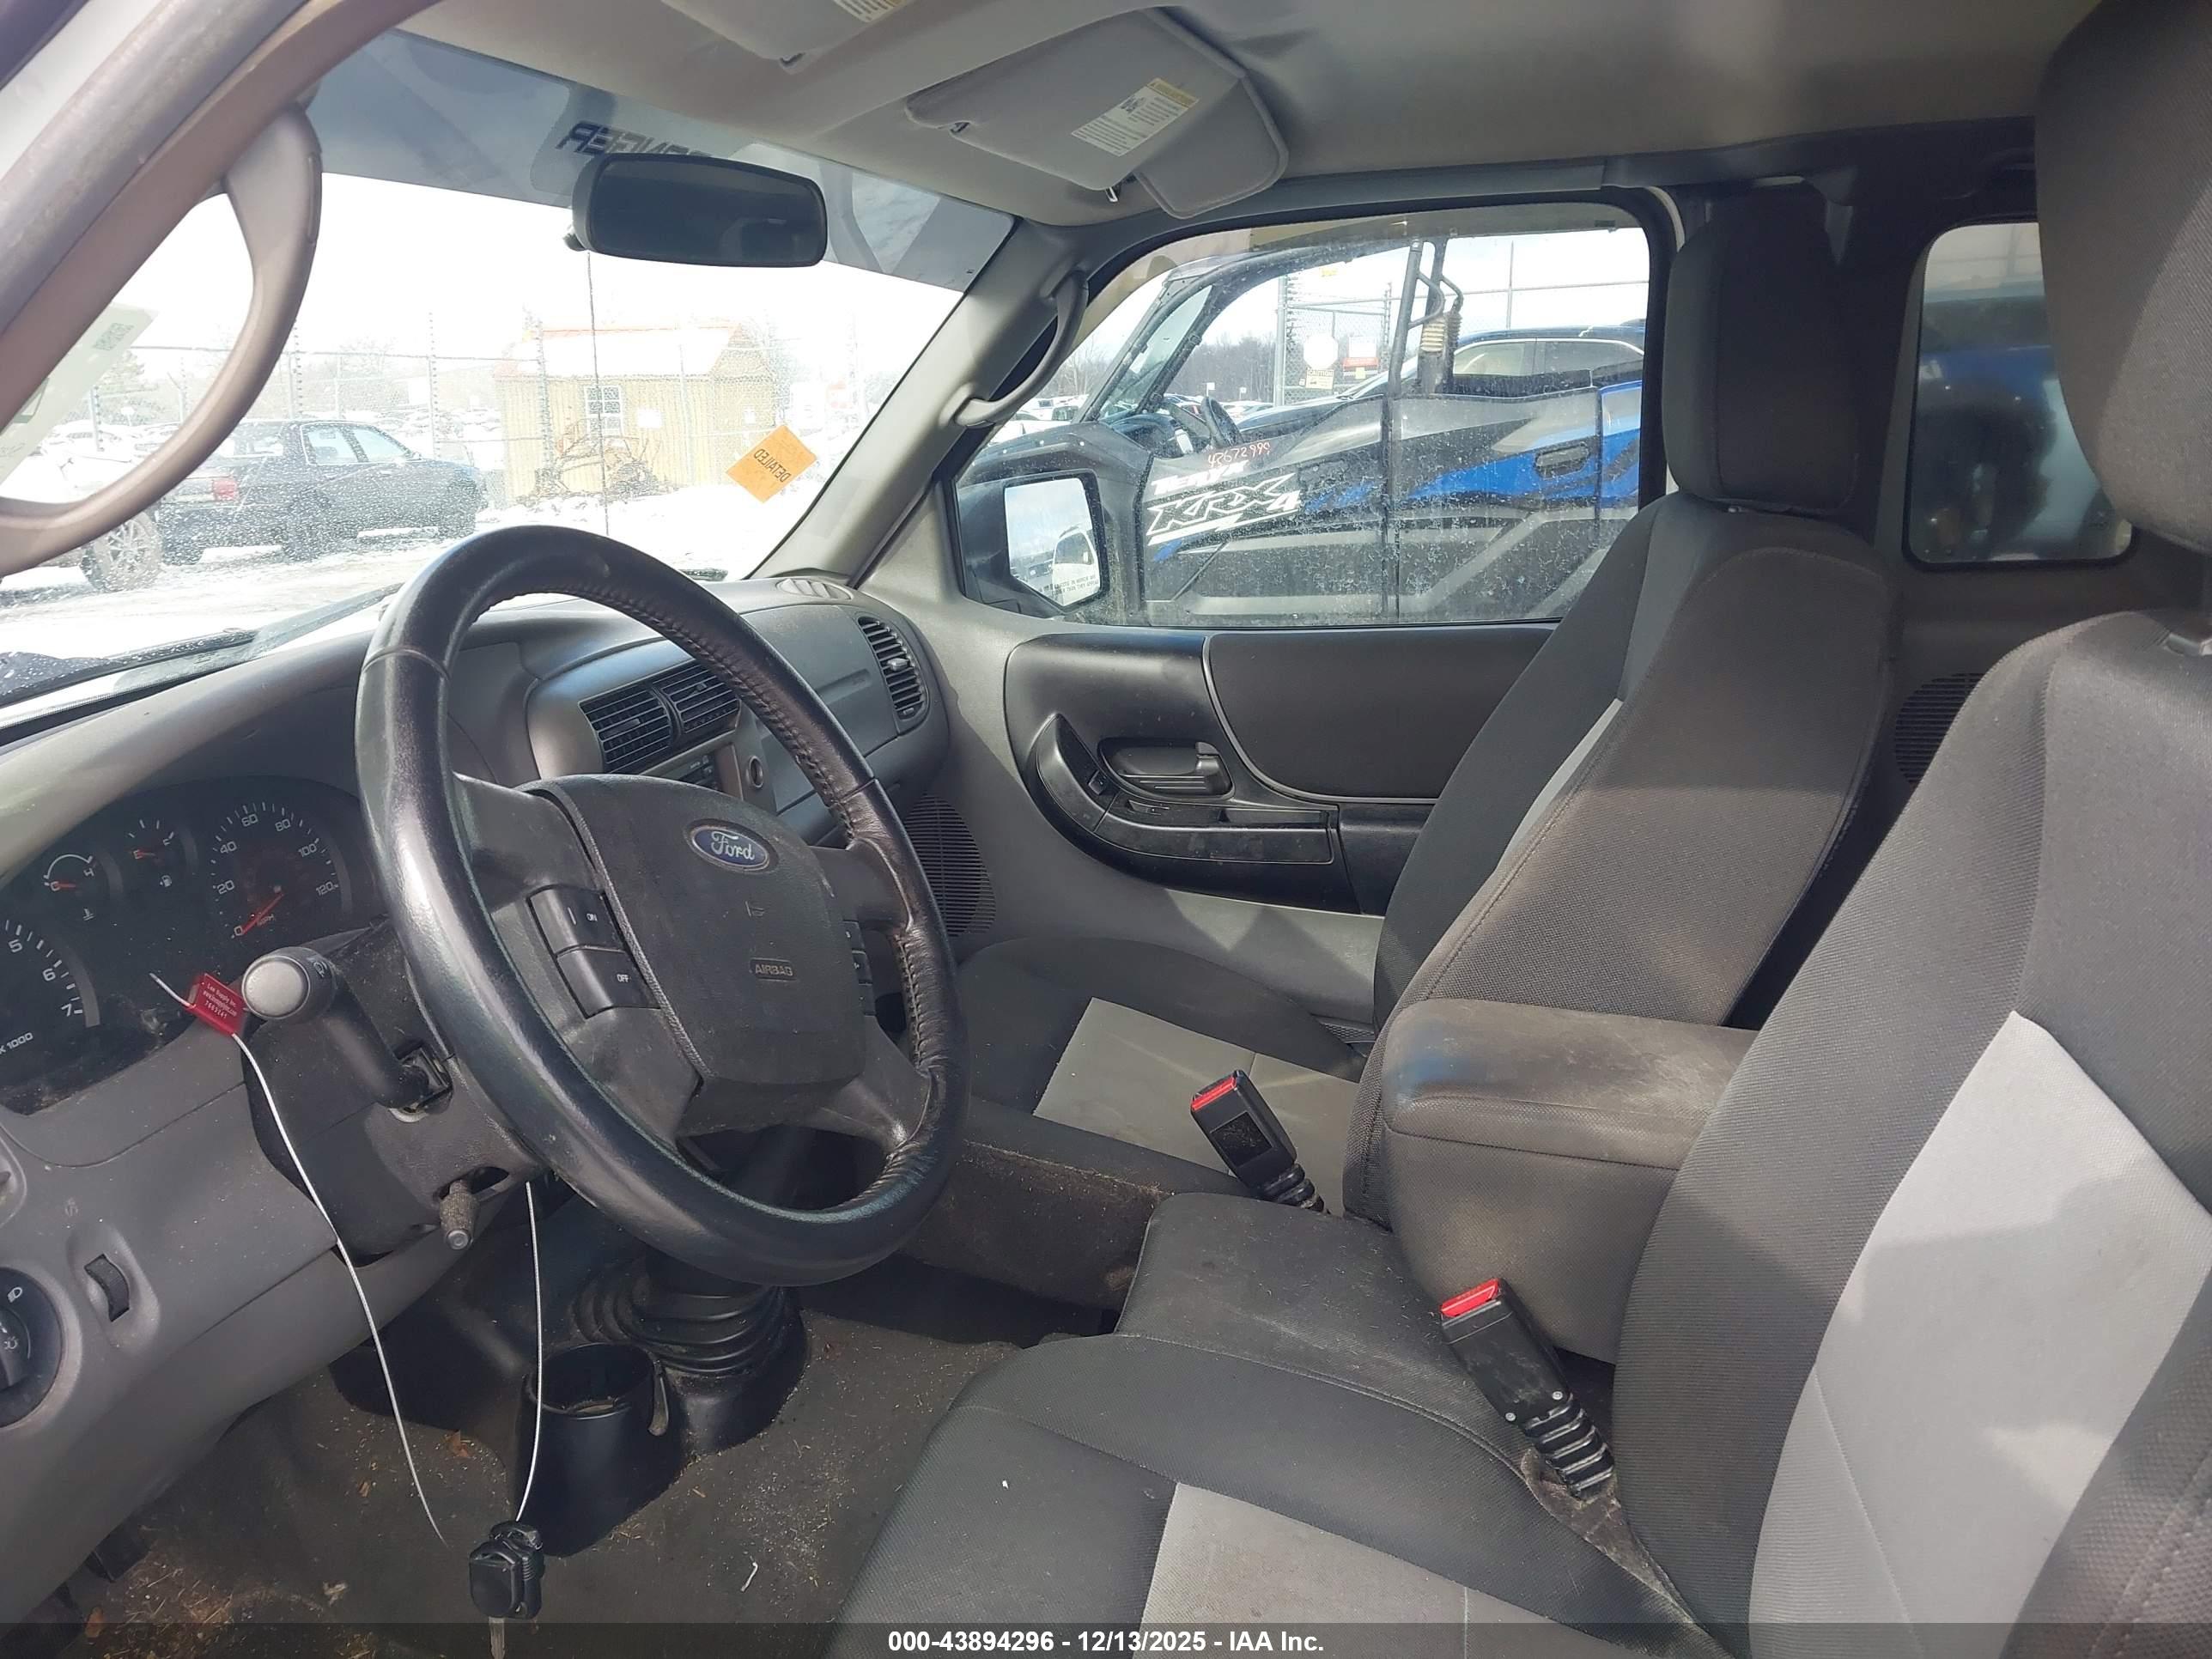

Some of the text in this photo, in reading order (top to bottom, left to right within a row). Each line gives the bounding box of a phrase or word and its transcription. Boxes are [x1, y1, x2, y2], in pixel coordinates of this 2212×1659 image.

[241, 814, 258, 827] 60
[275, 818, 291, 832] 80
[220, 841, 237, 854] 40
[298, 842, 318, 857] 100
[711, 830, 756, 861] Ford
[83, 867, 94, 877] H
[50, 881, 60, 891] C
[216, 880, 234, 895] 20
[315, 881, 334, 896] 120
[586, 913, 599, 922] ON
[234, 925, 244, 936] 0
[8, 939, 23, 952] 5
[43, 968, 57, 981] 6
[755, 963, 794, 977] AIRBAG
[617, 973, 629, 983] OFF
[61, 1003, 74, 1017] 7
[6, 1032, 33, 1049] 1000
